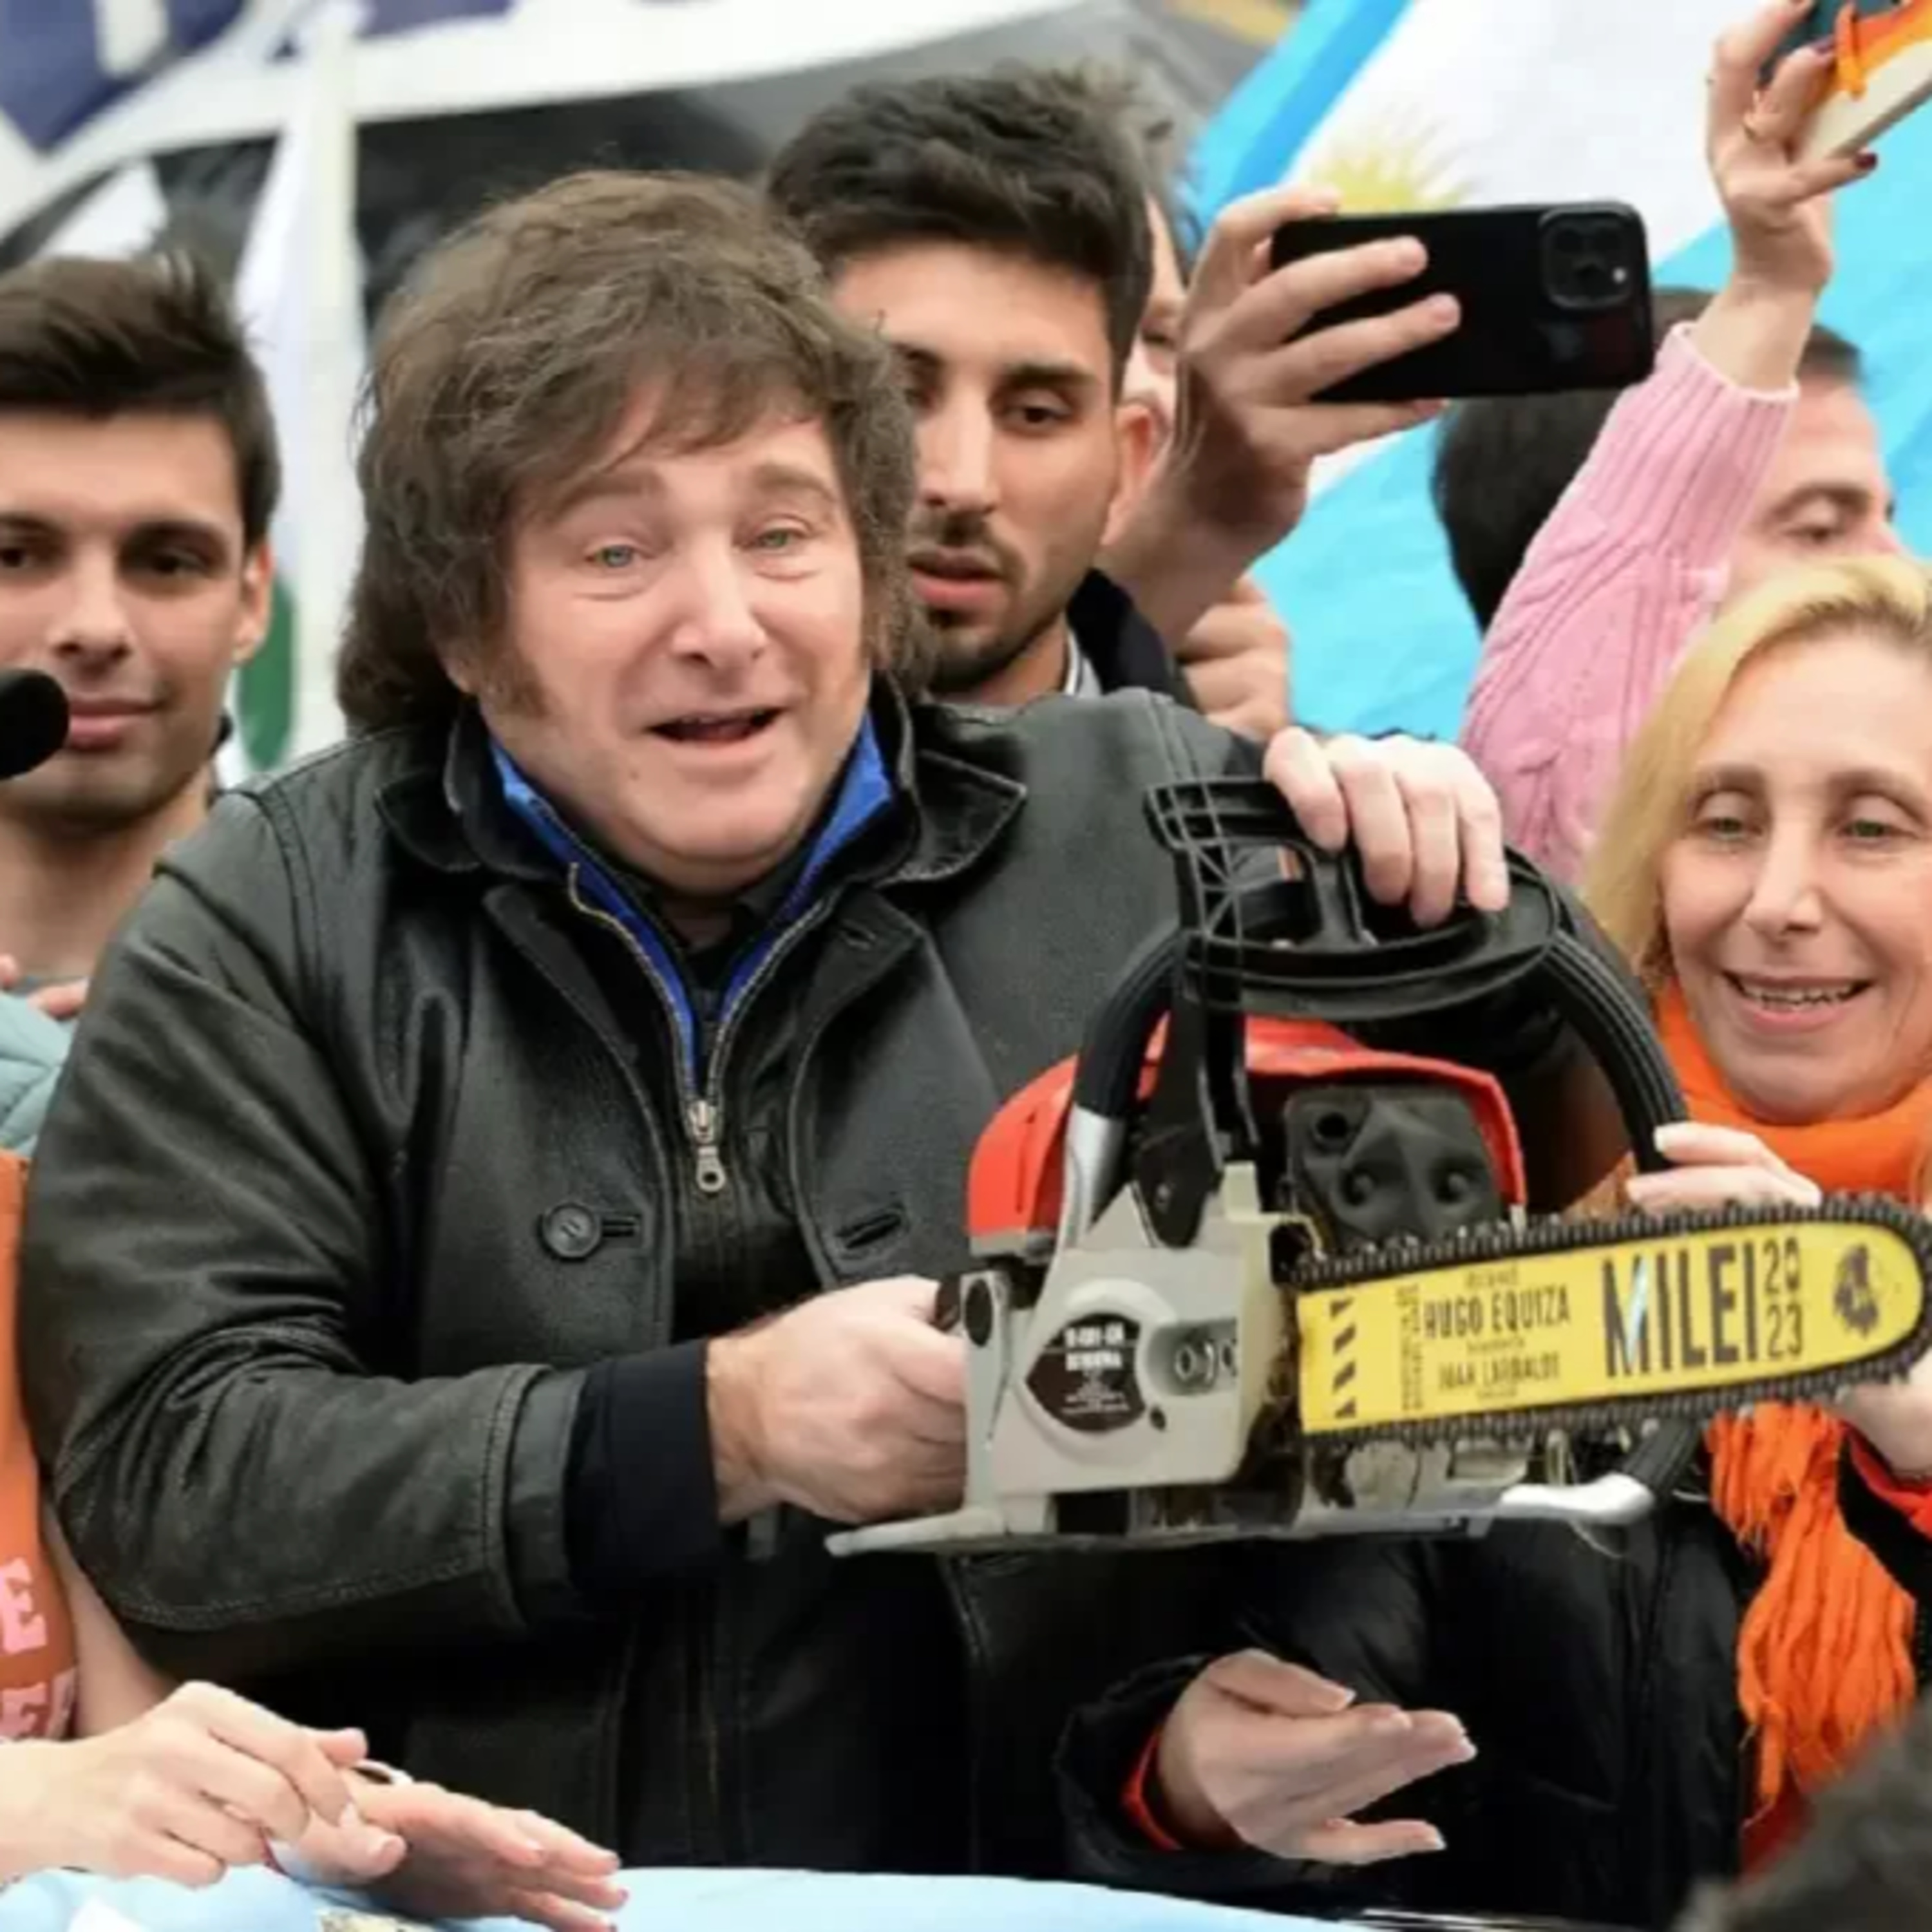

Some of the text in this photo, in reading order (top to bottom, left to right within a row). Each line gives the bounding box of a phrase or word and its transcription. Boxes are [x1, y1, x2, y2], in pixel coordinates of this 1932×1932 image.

[1764, 1237, 1799, 1294] 20
[1602, 1240, 1758, 1378] MILEI
[1767, 1303, 1804, 1359] 23
